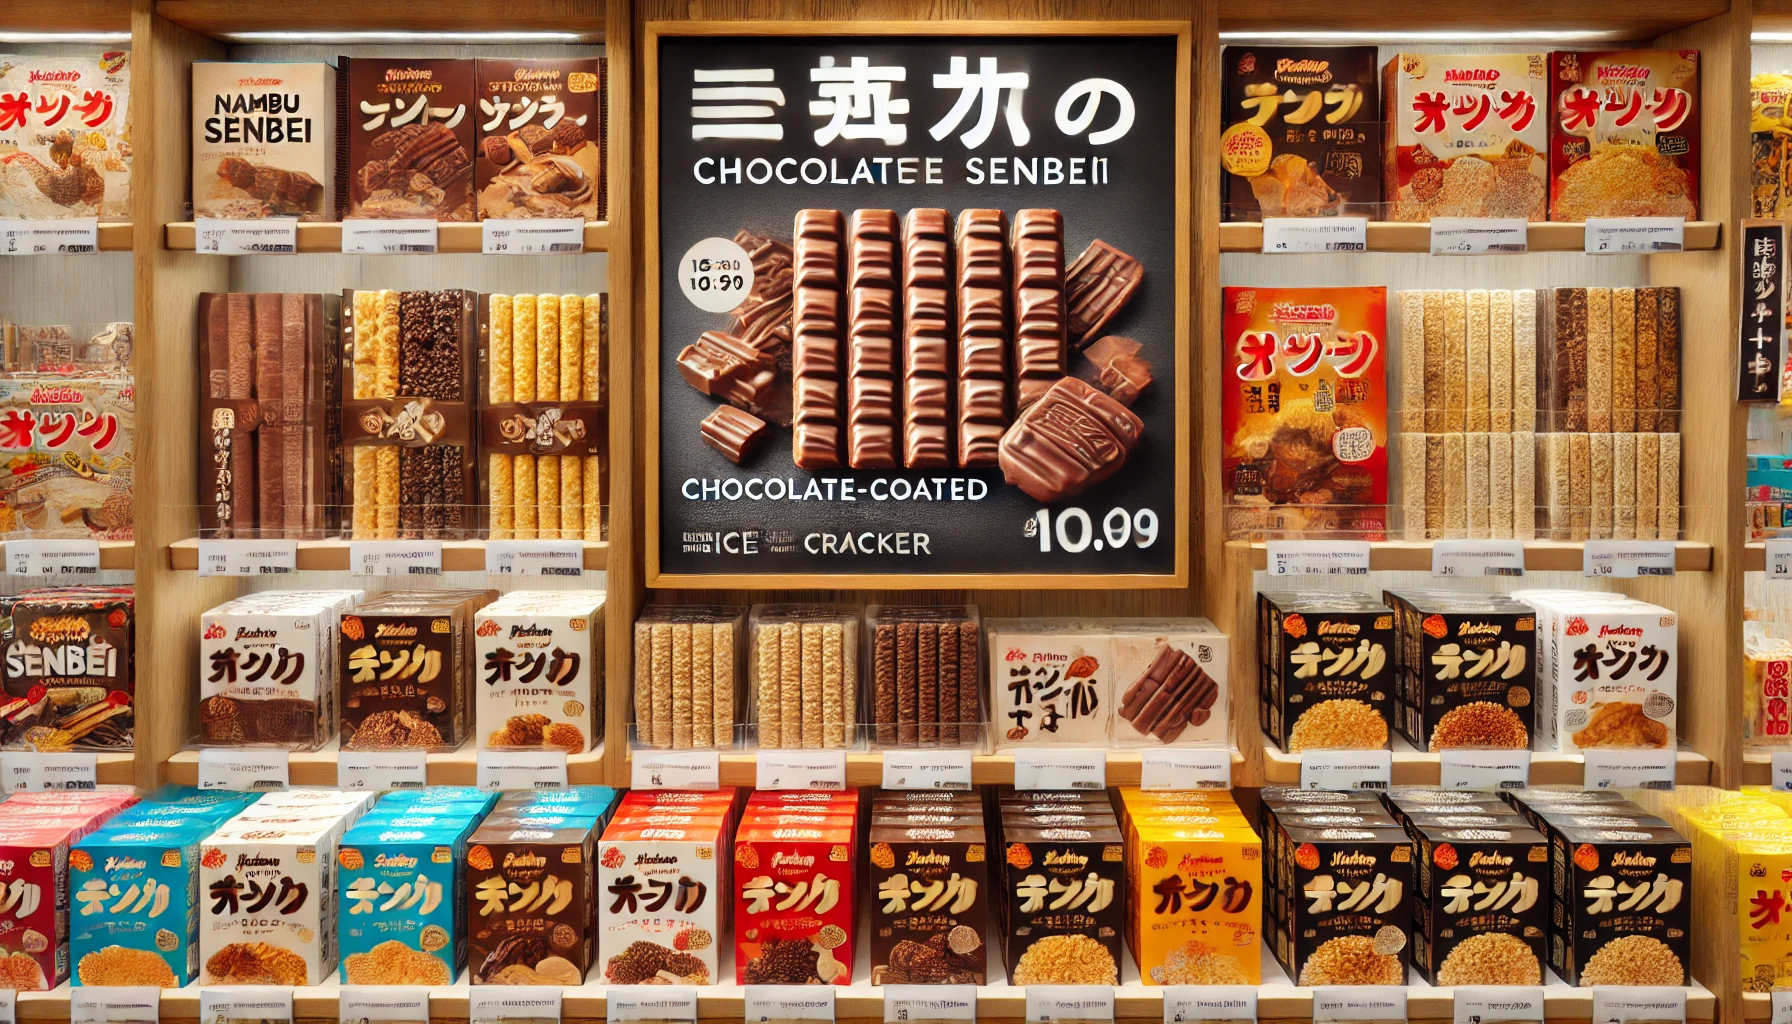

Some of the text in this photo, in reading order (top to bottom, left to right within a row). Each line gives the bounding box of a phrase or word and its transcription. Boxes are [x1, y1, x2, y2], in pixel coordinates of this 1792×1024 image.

[215, 94, 300, 116] NAMBU
[205, 118, 312, 144] SENBEI
[693, 157, 945, 185] CHOCOLATEE
[681, 477, 988, 502] CHOCOLATE-COATED
[804, 531, 932, 557] CRACKER
[6, 643, 118, 678] SENBEI
